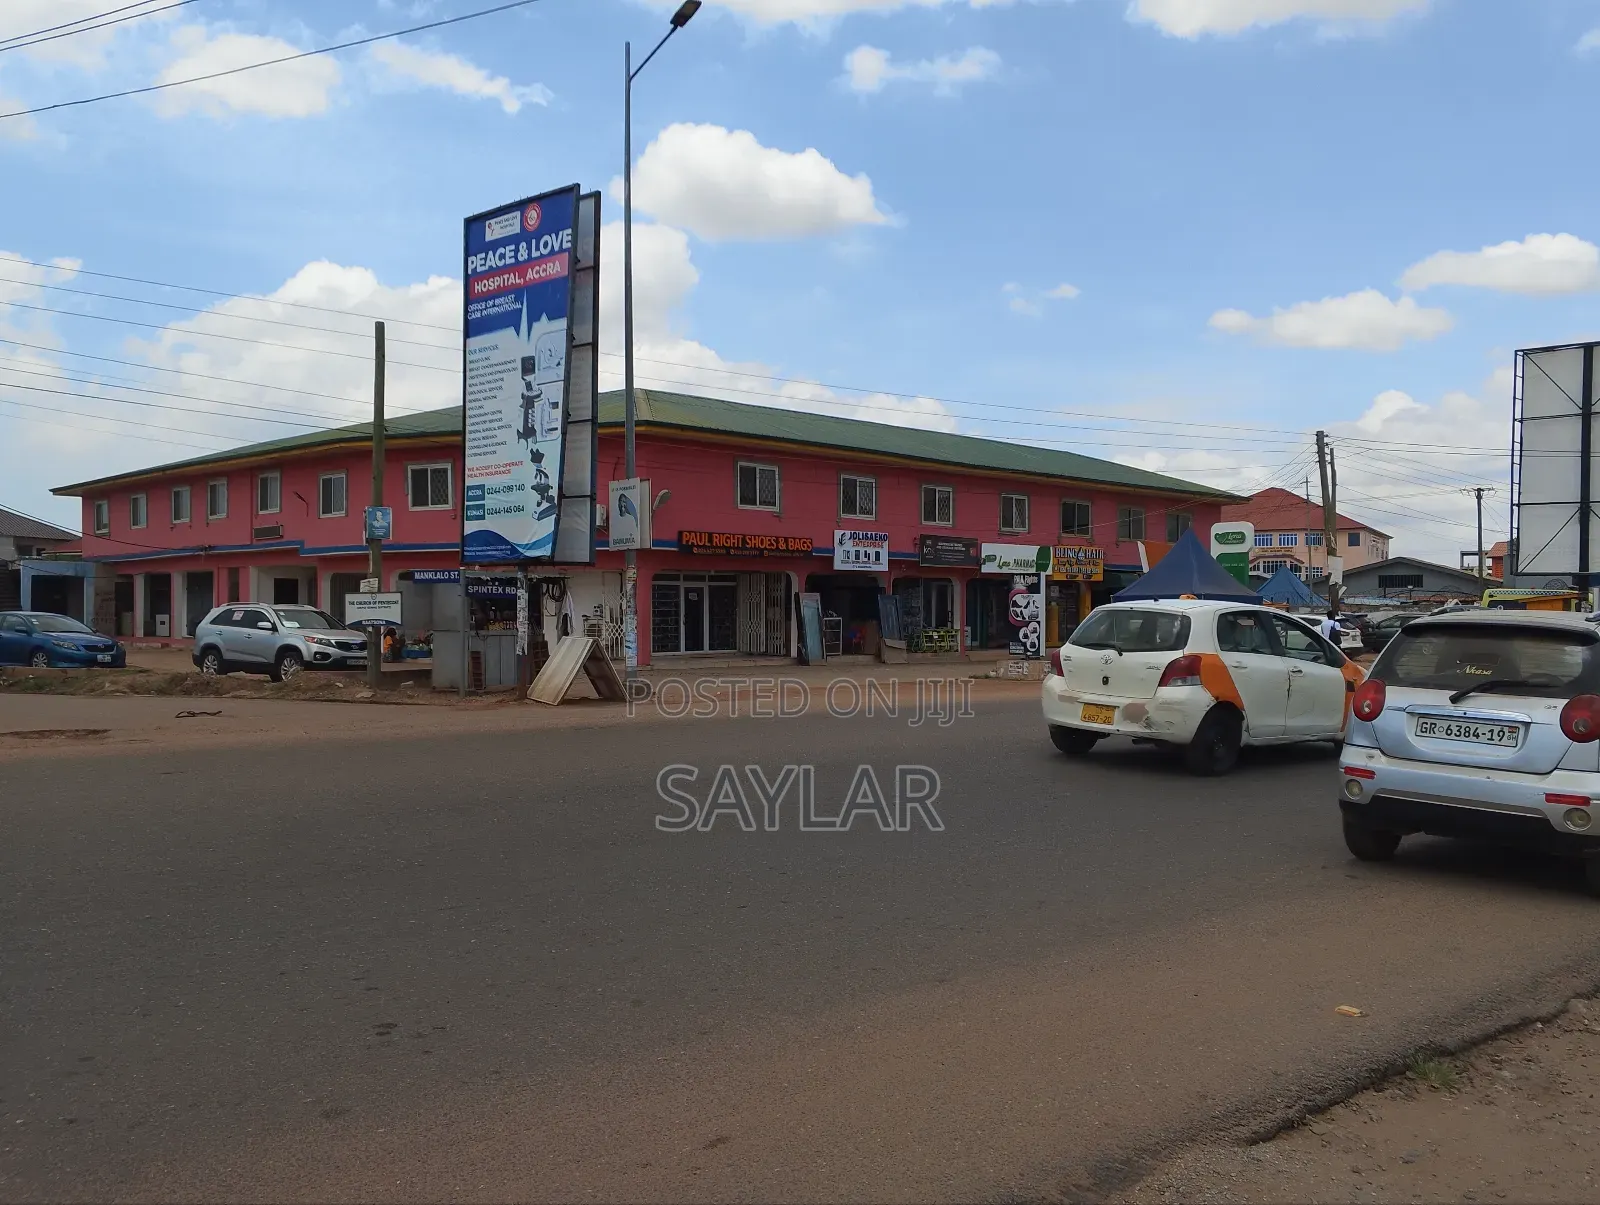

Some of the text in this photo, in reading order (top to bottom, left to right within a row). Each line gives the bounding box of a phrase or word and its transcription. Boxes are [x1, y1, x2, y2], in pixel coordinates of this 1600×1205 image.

[468, 228, 572, 275] PEACE & LOVE
[474, 259, 562, 294] HOSPITAL, ACCRA
[468, 301, 485, 312] OFFICE
[682, 532, 812, 552] PAUL RIGHT SHOES & BAGS
[852, 541, 885, 549] ENTERPRISE
[414, 571, 460, 580] MANKLALO ST.
[468, 586, 503, 594] SPINTEX
[1420, 721, 1506, 743] GR 6384-19
